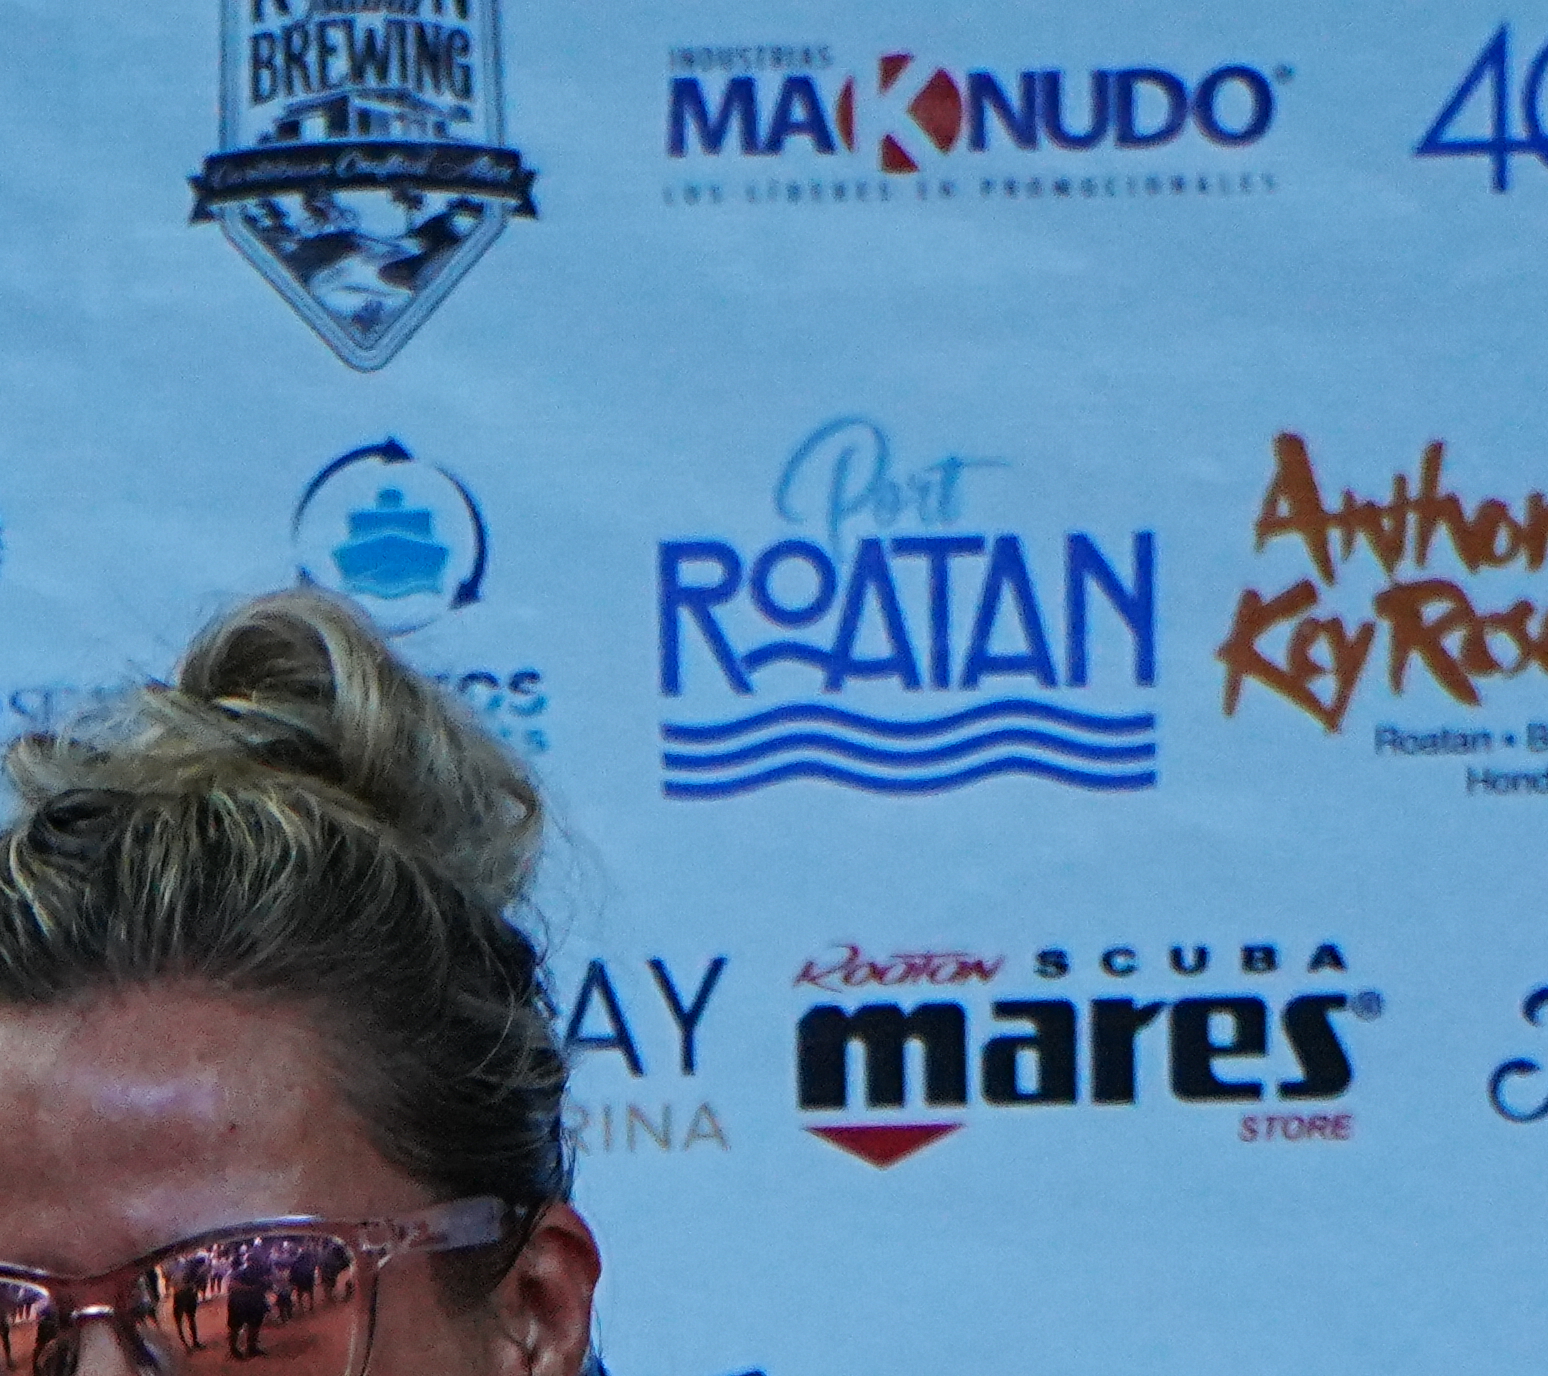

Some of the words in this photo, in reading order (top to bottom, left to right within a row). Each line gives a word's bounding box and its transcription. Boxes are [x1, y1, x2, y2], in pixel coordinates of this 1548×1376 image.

[248, 14, 474, 106] BREWING
[657, 530, 1158, 698] ROATAN
[1215, 577, 1379, 734] Key
[1374, 722, 1492, 757] Roatan
[1033, 942, 1351, 980] SCUBA
[795, 992, 1356, 1112] mares
[1238, 1112, 1354, 1143] STORE
